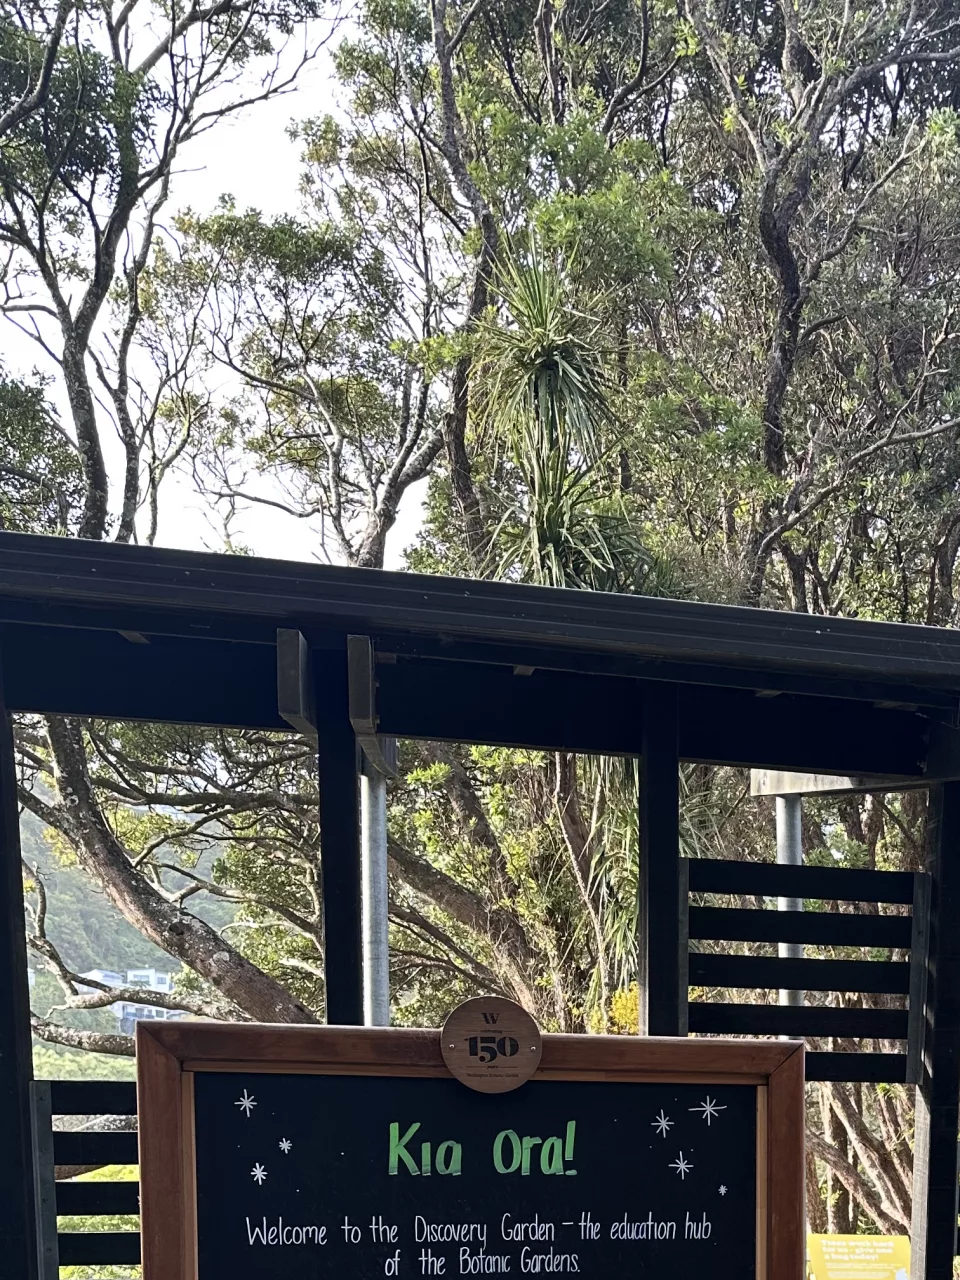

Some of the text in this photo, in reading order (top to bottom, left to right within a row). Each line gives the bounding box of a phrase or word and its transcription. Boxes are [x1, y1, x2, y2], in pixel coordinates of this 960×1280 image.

[482, 1012, 500, 1025] W
[464, 1036, 519, 1063] 150
[388, 1120, 578, 1177] Kia Ora!
[245, 1216, 328, 1246] Welcome
[340, 1215, 362, 1244] to
[368, 1215, 399, 1243] the
[414, 1214, 488, 1251] Discovery
[501, 1212, 555, 1242] Garden
[578, 1211, 601, 1240] the
[610, 1211, 677, 1240] education
[684, 1211, 712, 1240] hub
[384, 1245, 582, 1277] of the Botanic Gardens.
